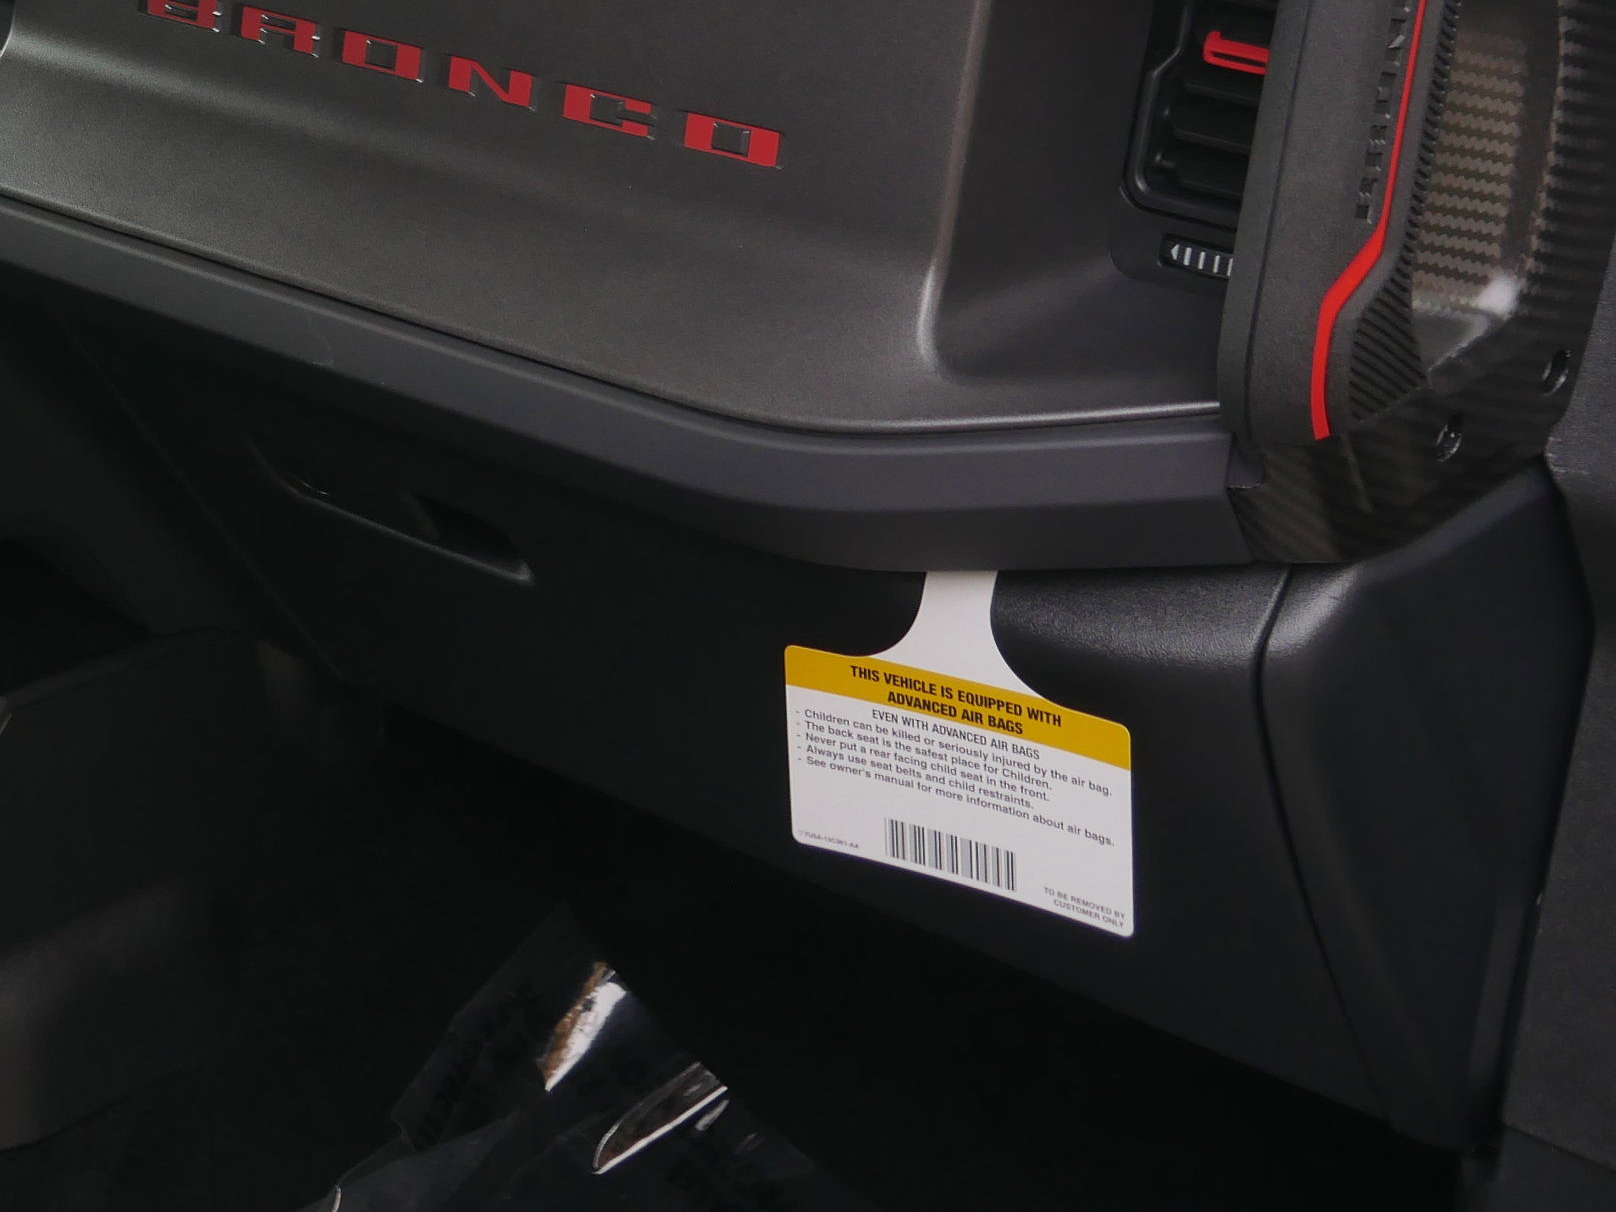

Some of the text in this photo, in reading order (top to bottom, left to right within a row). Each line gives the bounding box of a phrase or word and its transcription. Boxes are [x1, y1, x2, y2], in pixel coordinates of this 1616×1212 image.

[850, 665, 1061, 727] THIS VEHICLE IS EQUIPPED WITH
[888, 691, 1023, 735] ADVANCED AIR BAGS
[805, 709, 1112, 797] Children can be killed or seriously injured by the air bag.
[805, 721, 1052, 790] The back seat is the safest place for Children.
[806, 733, 836, 746] Never
[840, 742, 857, 752] put
[870, 749, 891, 759] rear
[894, 753, 927, 770] facing
[931, 763, 957, 776] child
[961, 771, 983, 783] seat
[987, 776, 997, 787] in
[1000, 780, 1017, 792] the
[1021, 785, 1049, 801] front.
[873, 709, 1040, 760] EVEN WITH ADVANCED AIR BAGS
[807, 745, 1034, 809] Always use seat belts and child restraints.
[807, 756, 1114, 846] See owner's manual for more information about air bags.
